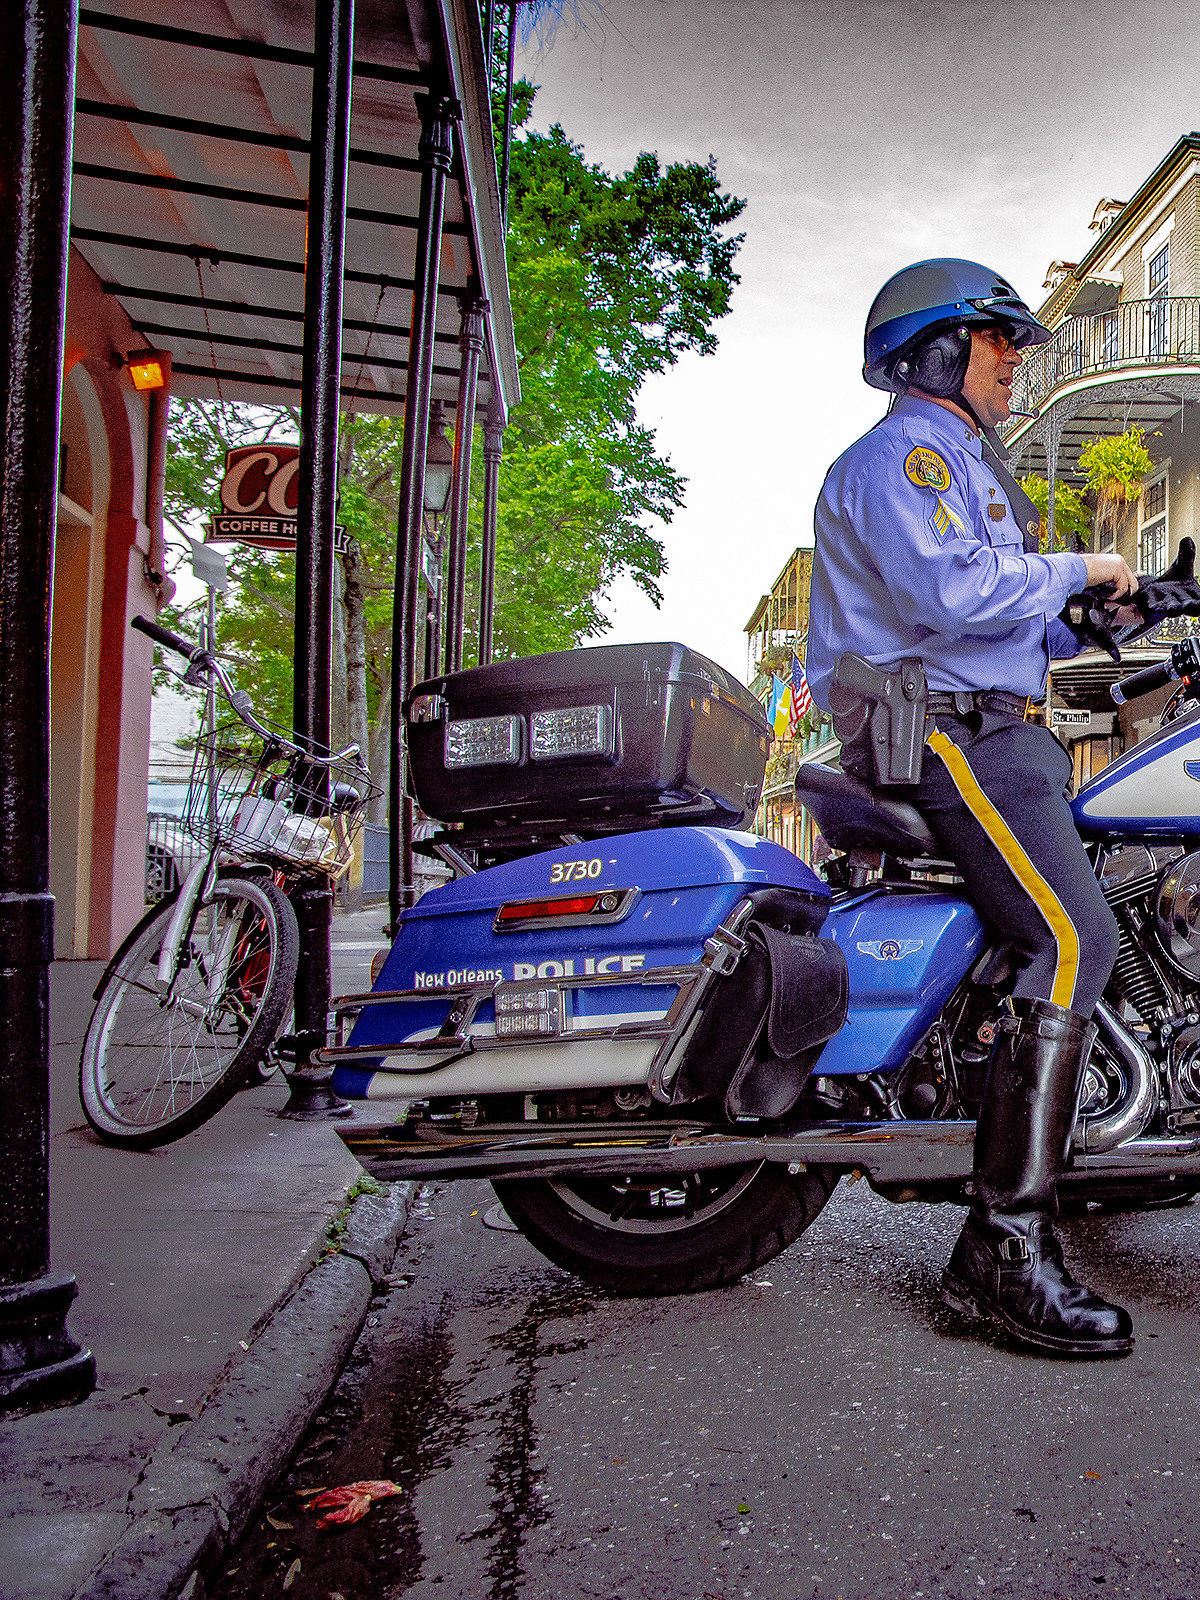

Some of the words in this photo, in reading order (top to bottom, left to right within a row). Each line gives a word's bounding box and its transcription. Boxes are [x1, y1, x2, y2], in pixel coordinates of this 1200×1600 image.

[219, 520, 279, 533] COFFEE
[1053, 713, 1064, 722] St.
[1066, 713, 1089, 723] Philip
[550, 858, 603, 884] 3730
[414, 970, 444, 989] New
[446, 968, 503, 986] Orleans
[513, 954, 646, 981] POLICE
